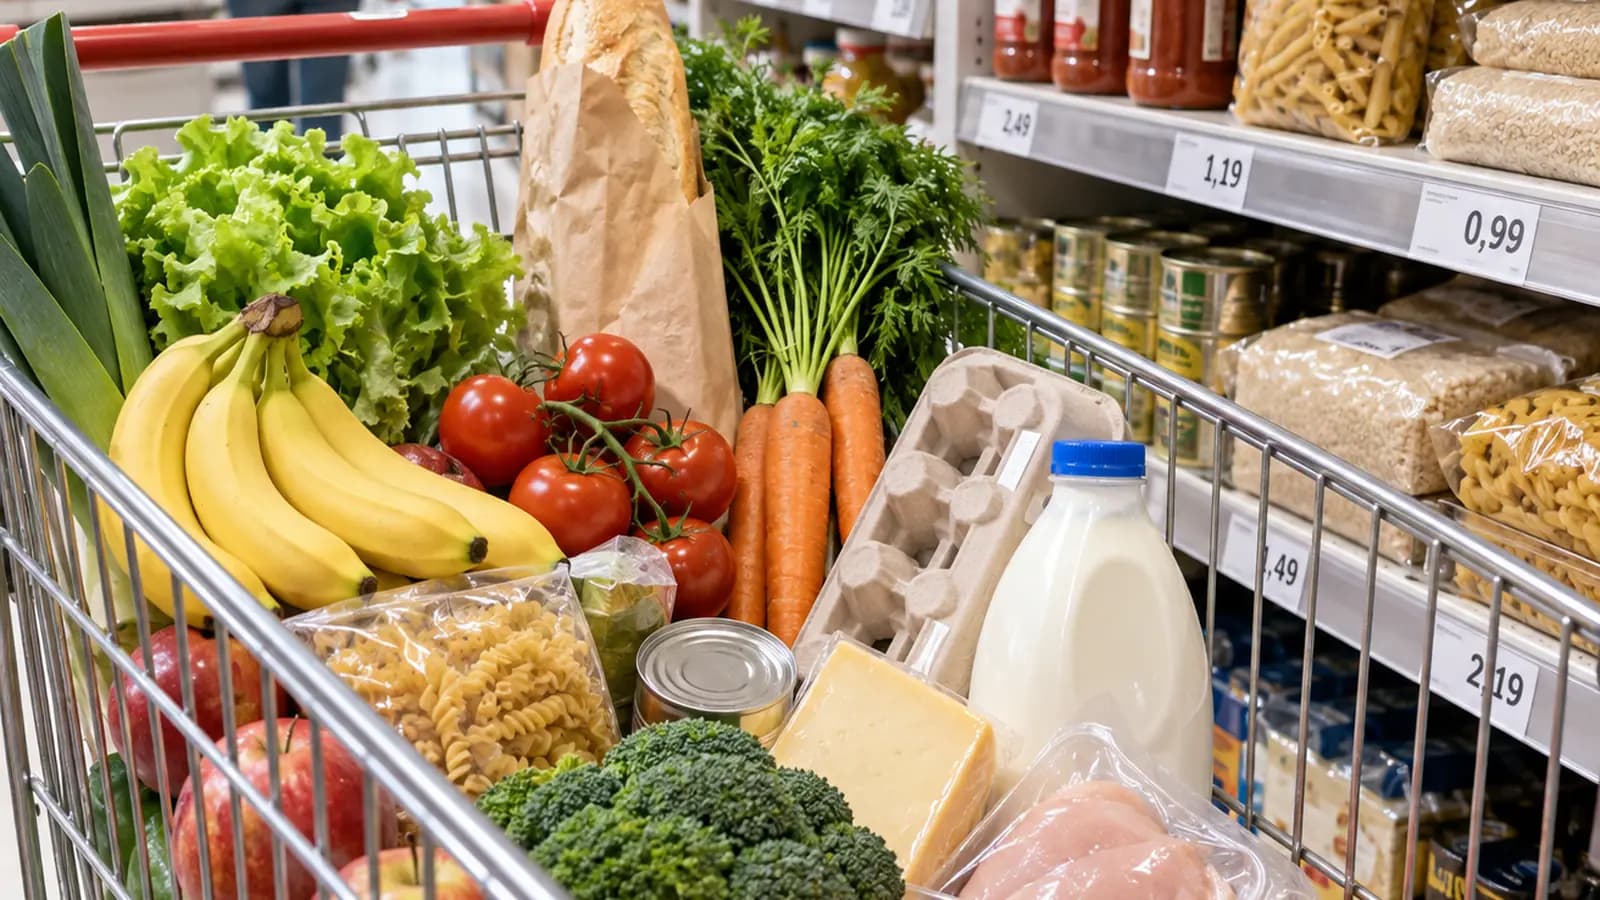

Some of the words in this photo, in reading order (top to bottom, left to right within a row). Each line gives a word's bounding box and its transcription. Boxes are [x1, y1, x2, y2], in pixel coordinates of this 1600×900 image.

[1002, 108, 1031, 137] 2,49
[1203, 153, 1242, 189] 1,19
[1464, 209, 1525, 254] 0,99
